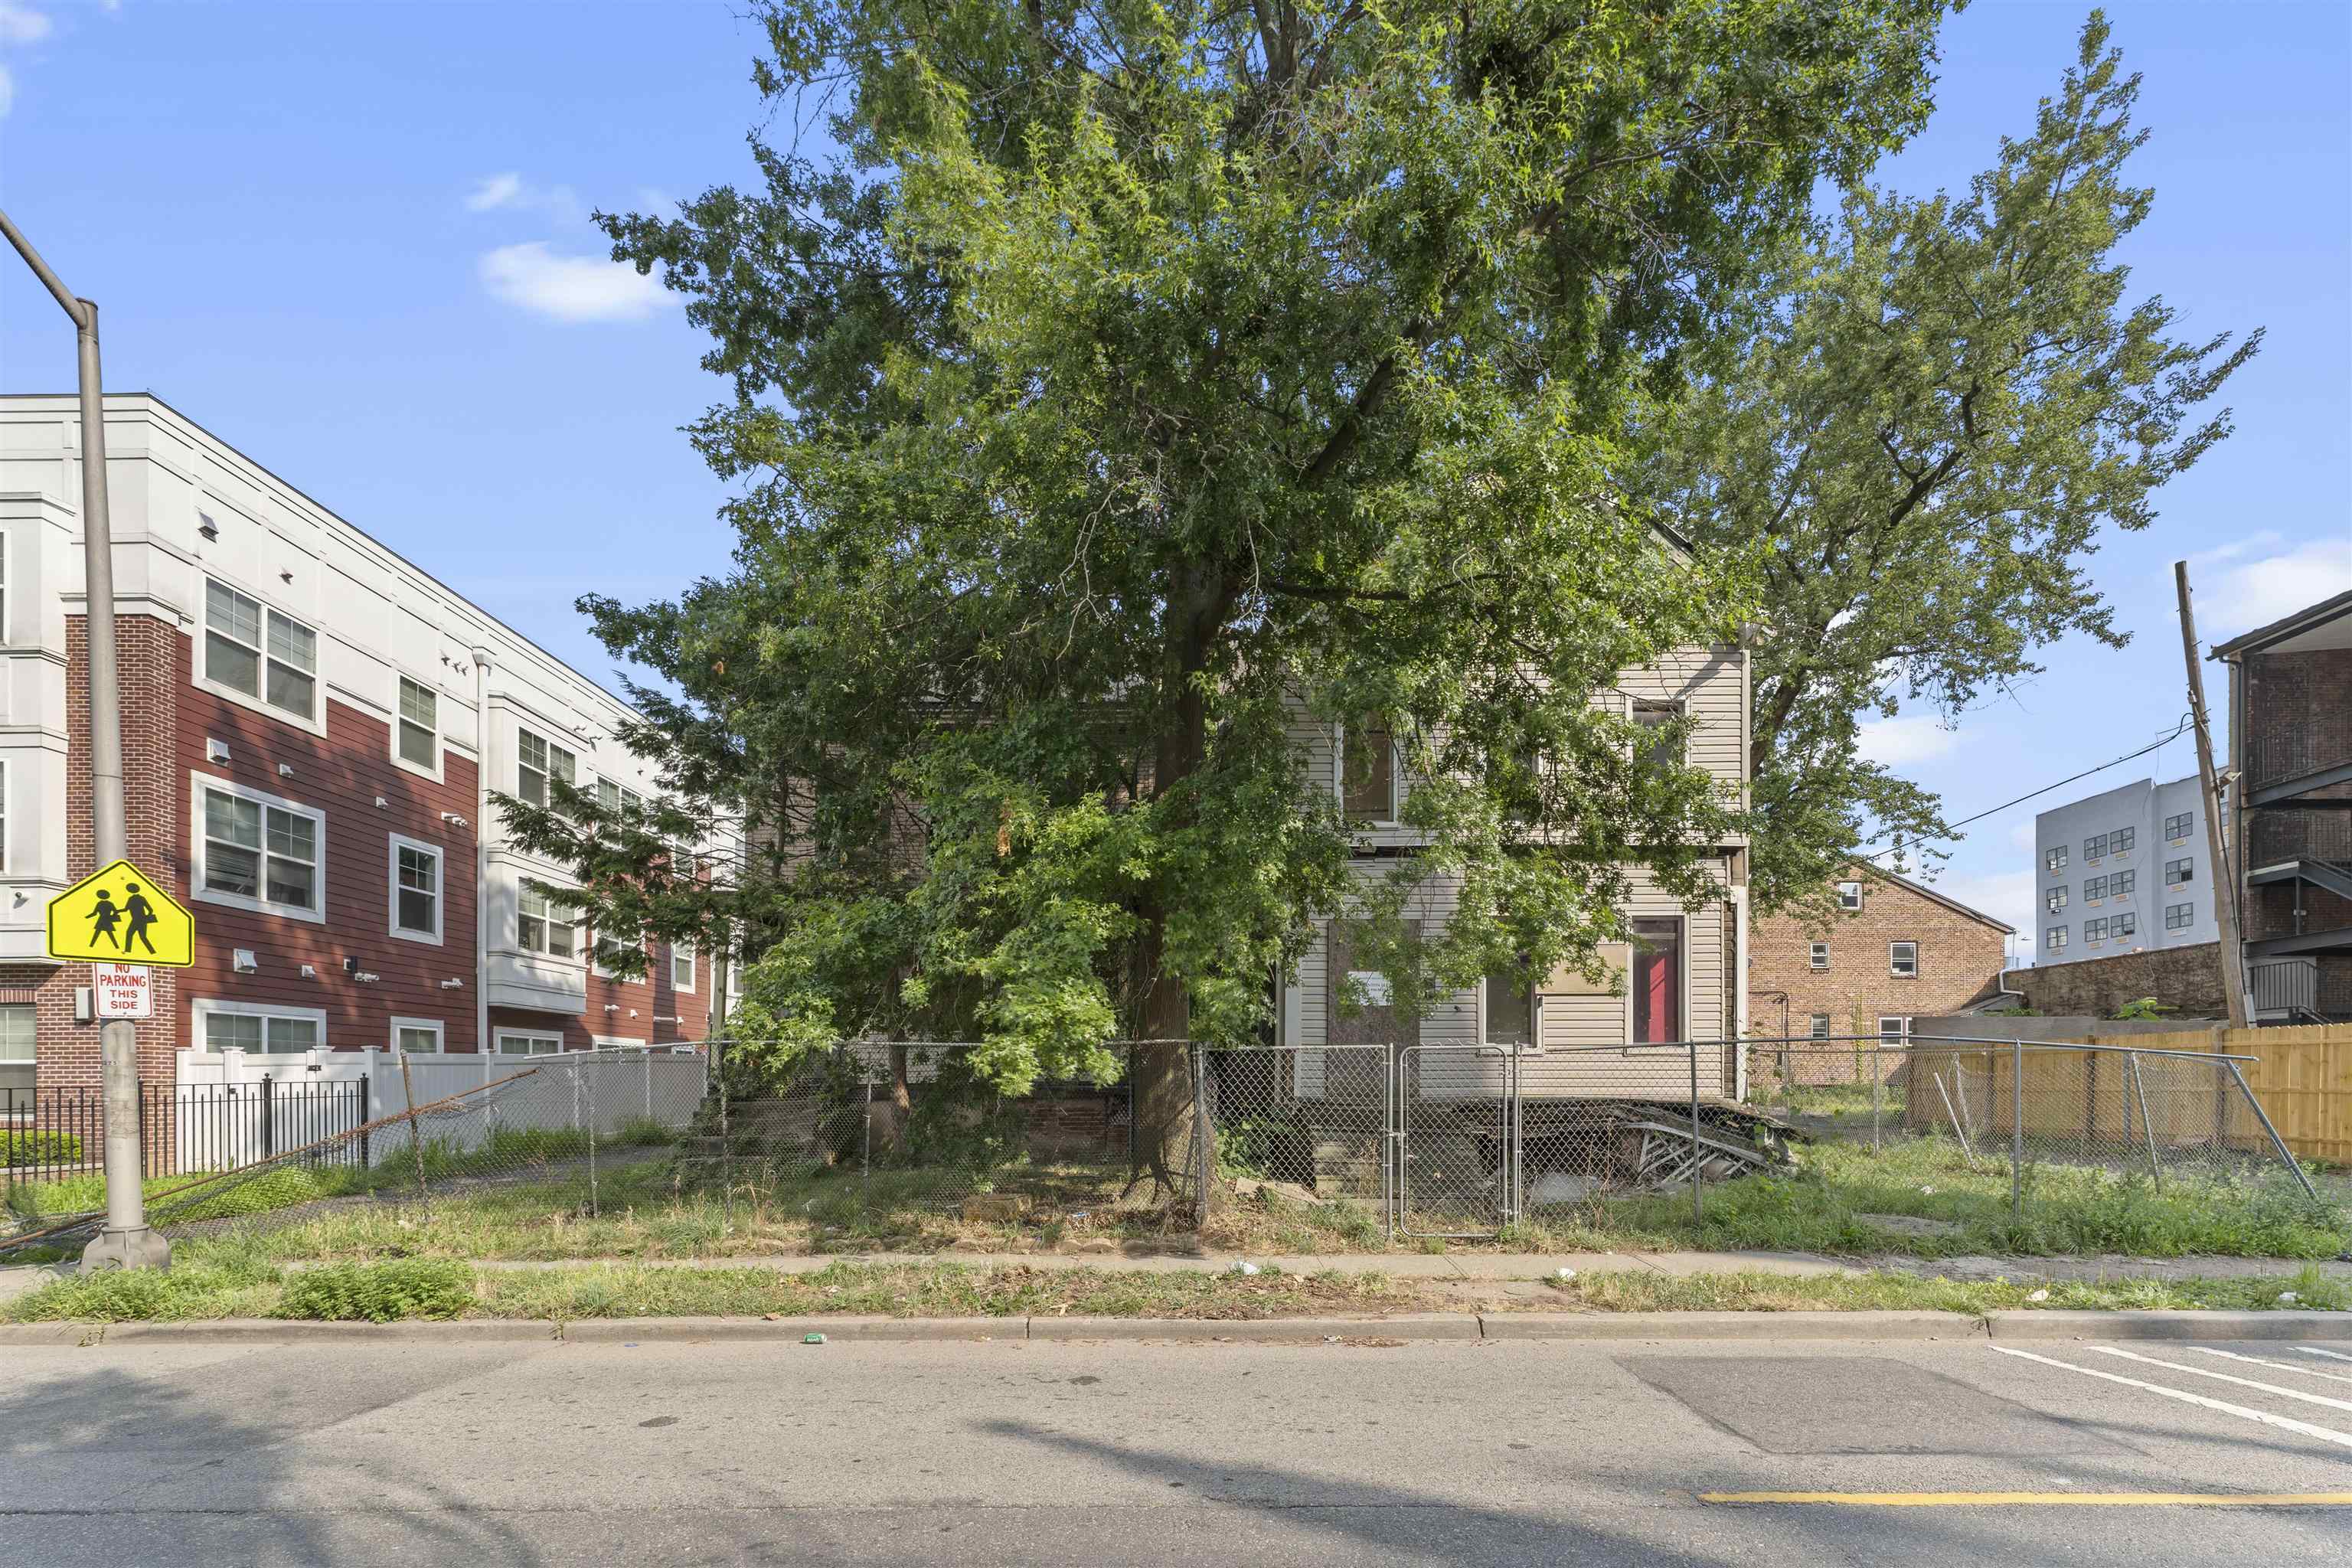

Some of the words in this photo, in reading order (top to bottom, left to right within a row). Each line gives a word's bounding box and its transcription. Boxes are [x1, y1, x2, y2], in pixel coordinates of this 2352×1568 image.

[115, 963, 130, 973] NO
[100, 975, 146, 987] PARKING
[109, 989, 138, 998] THIS
[110, 1001, 138, 1009] SIDE
